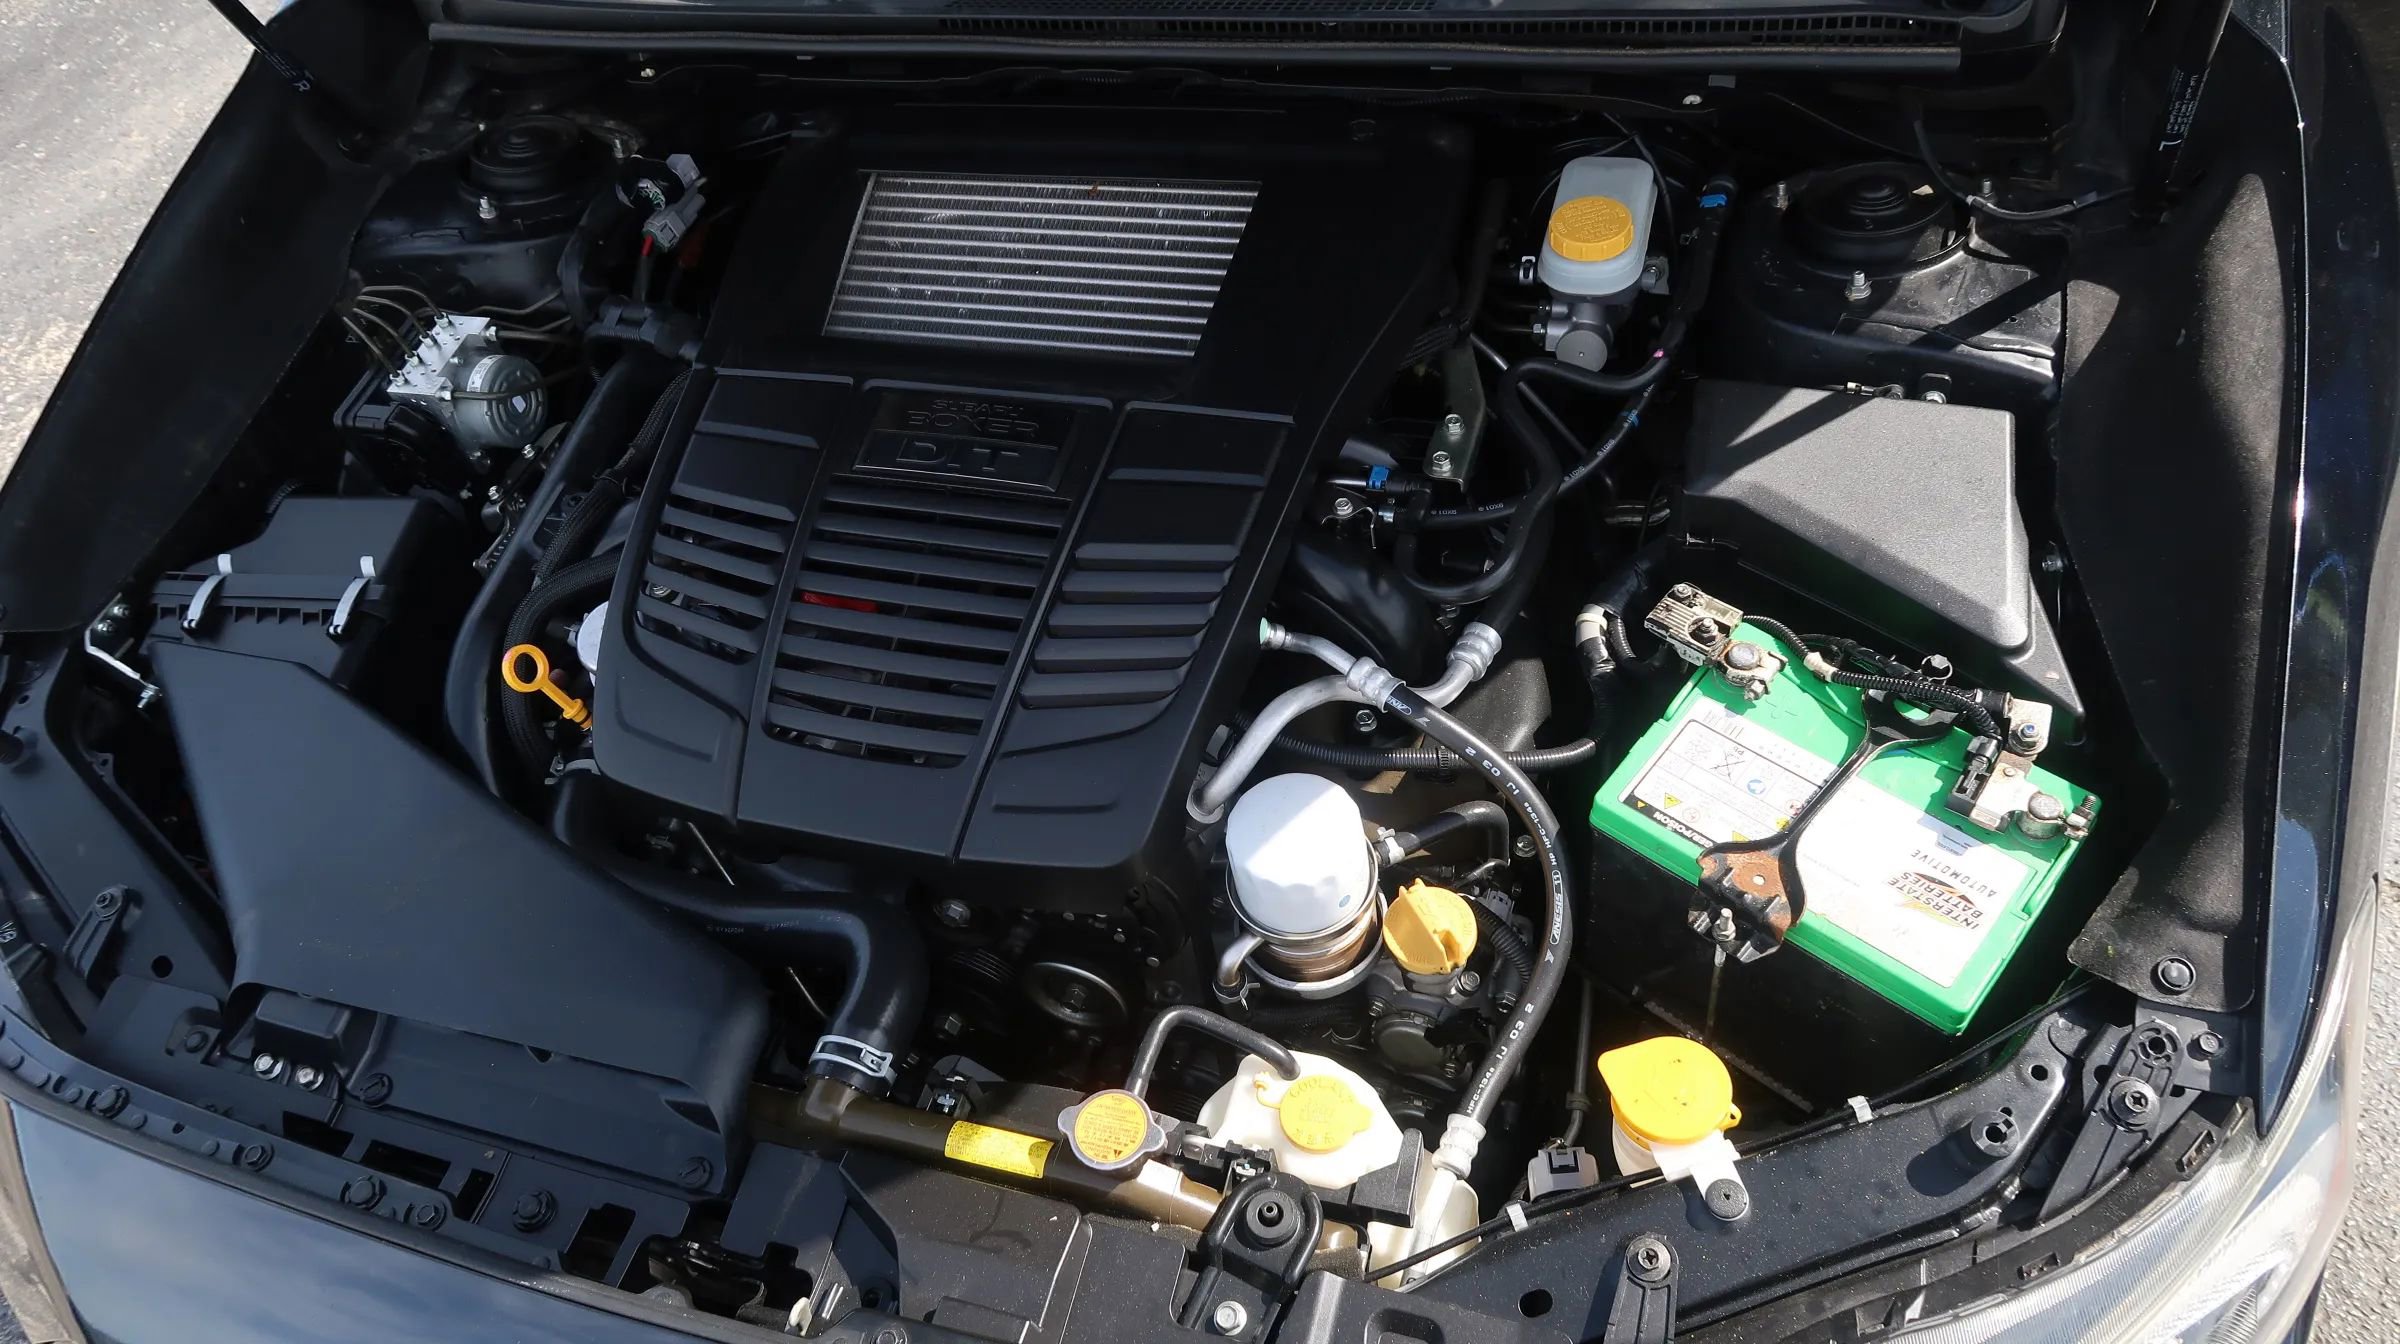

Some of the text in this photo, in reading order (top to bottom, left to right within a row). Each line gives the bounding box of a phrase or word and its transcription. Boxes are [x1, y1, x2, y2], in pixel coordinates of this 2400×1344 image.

[907, 410, 1040, 437] BOXER
[932, 399, 1025, 417] SUBARU
[1465, 746, 1477, 757] 2
[1653, 811, 1714, 848] GER/POISON
[1910, 849, 1998, 898] AUTOMOTIVE
[1888, 877, 1980, 930] INTERSTATE
[1901, 871, 1983, 919] BATTERIES
[1525, 1003, 1534, 1013] 2
